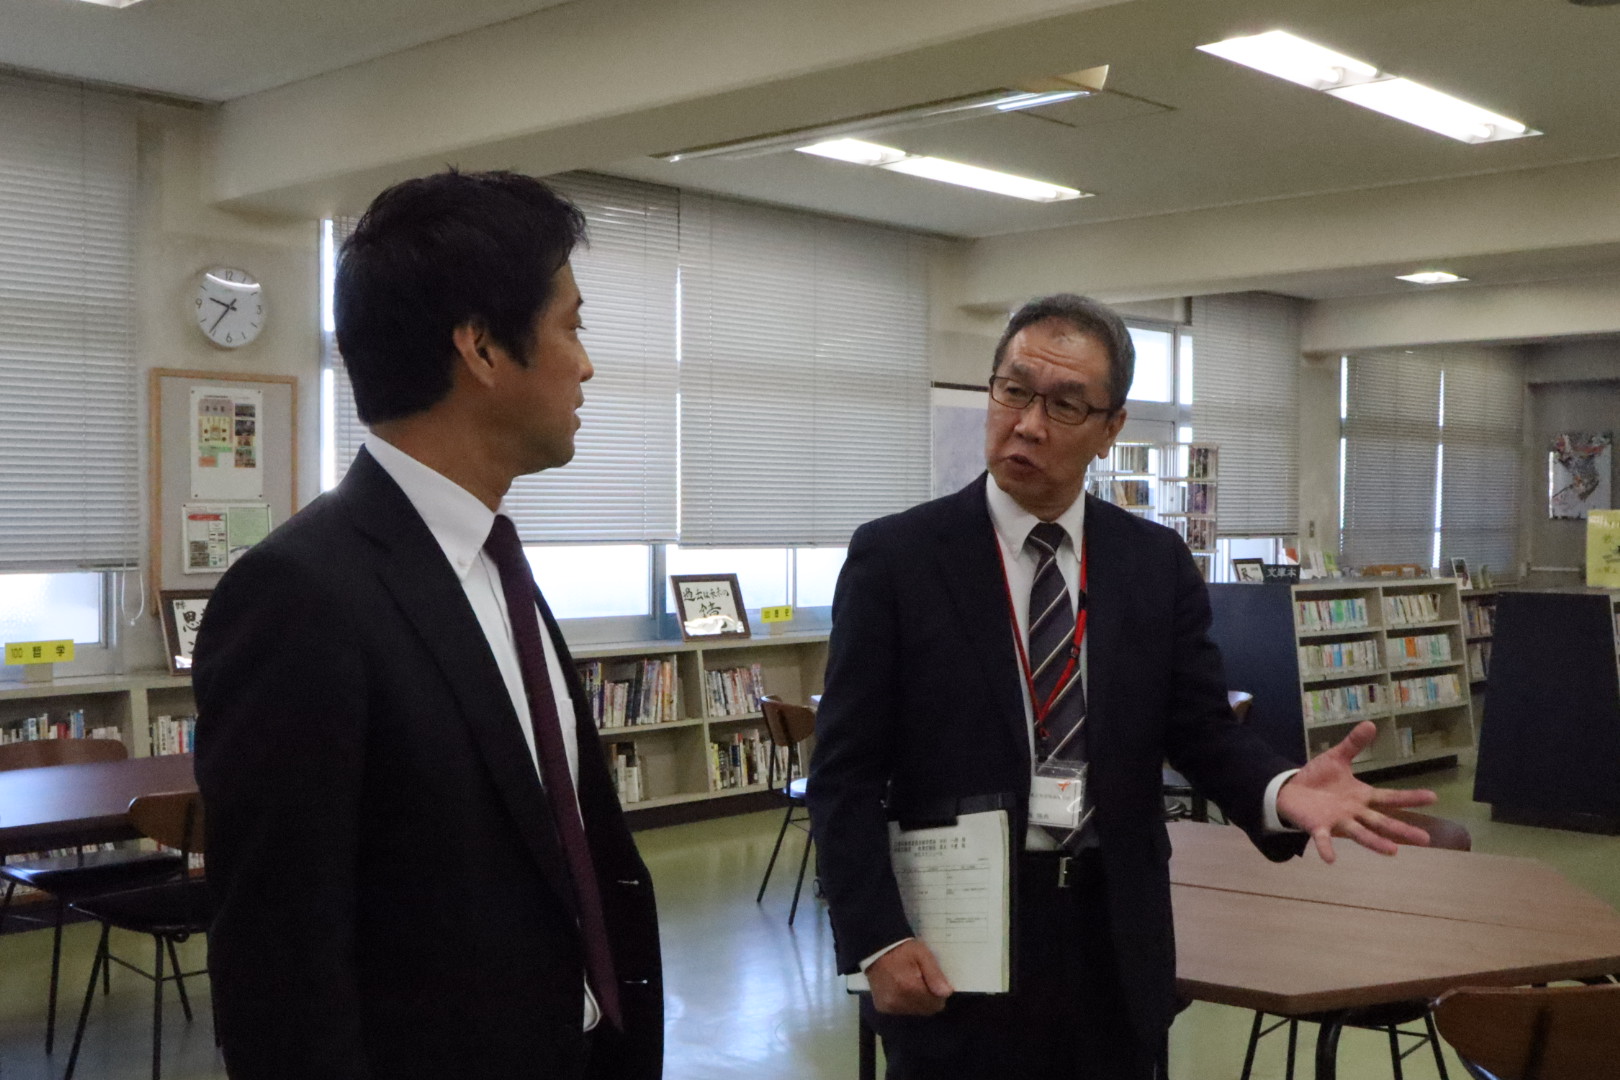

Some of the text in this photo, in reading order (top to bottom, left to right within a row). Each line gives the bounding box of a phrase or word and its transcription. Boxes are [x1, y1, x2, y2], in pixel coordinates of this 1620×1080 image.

[225, 270, 233, 281] 12
[195, 298, 202, 309] 9
[256, 304, 262, 315] 3
[225, 332, 233, 343] 6
[1266, 566, 1297, 578] 文庫本
